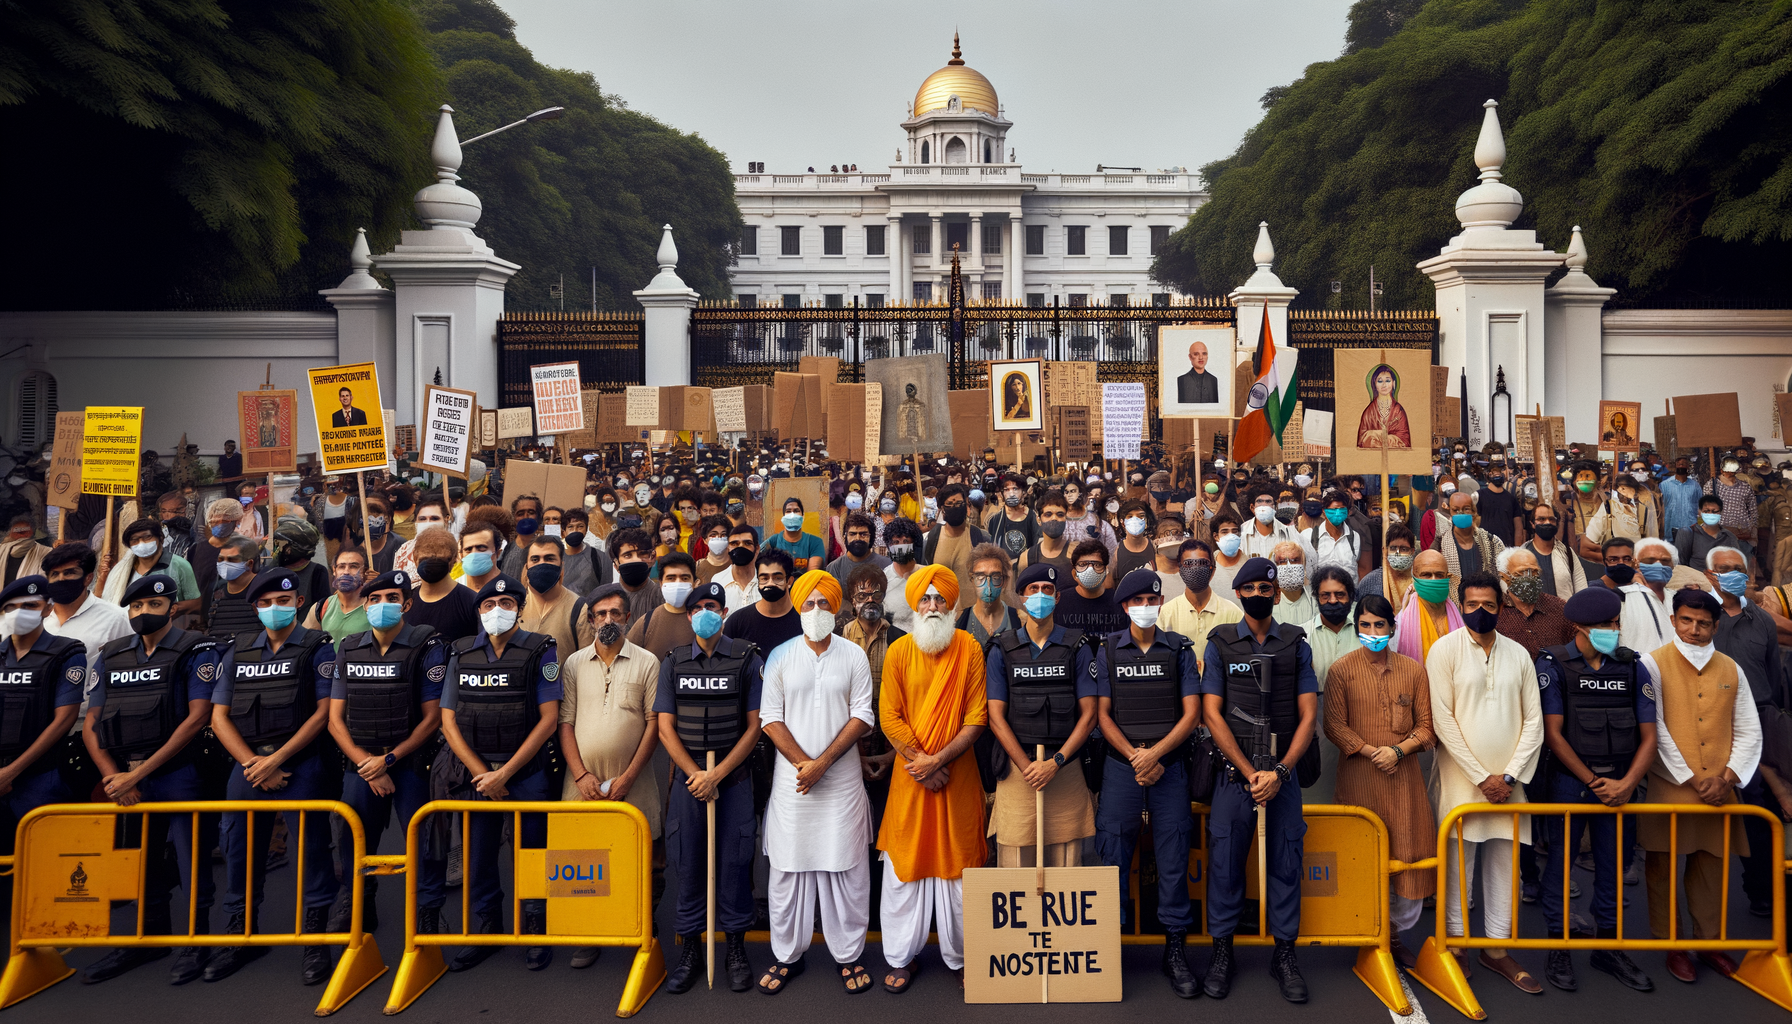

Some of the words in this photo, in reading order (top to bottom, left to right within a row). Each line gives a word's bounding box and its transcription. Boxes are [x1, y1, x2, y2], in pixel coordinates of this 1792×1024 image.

[679, 677, 729, 690] POLICE
[991, 890, 1028, 930] BE
[1041, 889, 1098, 928] RUE
[1028, 931, 1052, 949] TE
